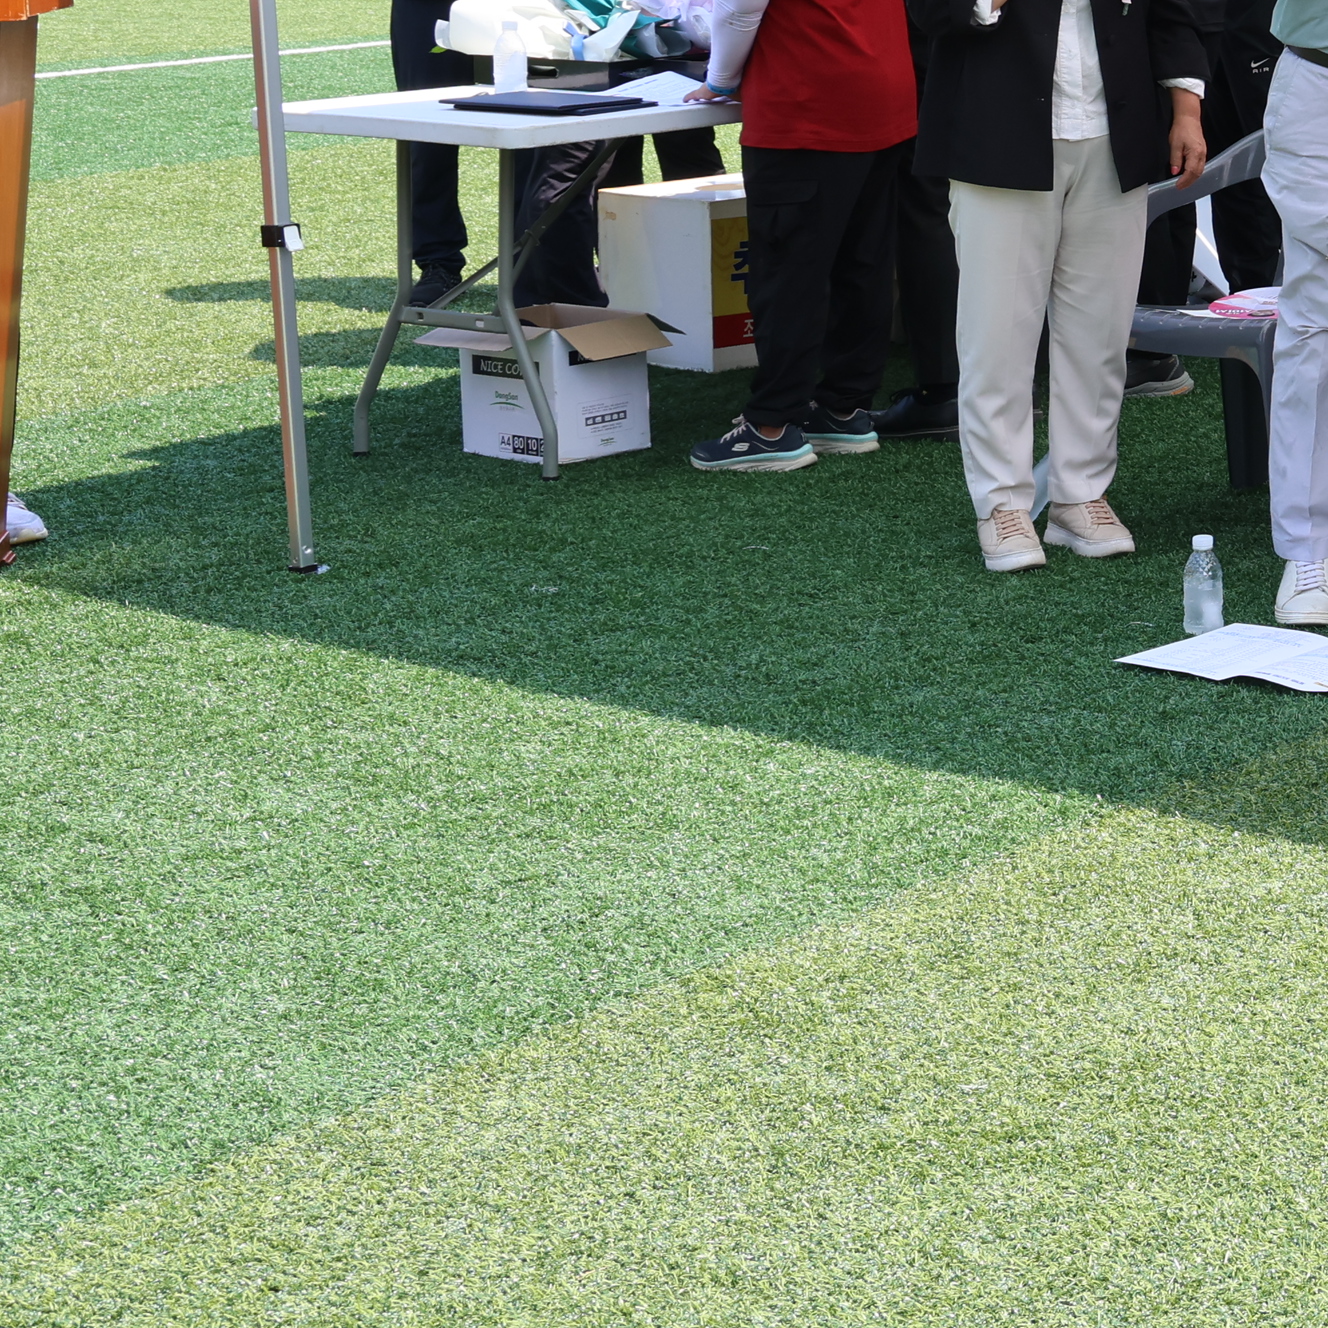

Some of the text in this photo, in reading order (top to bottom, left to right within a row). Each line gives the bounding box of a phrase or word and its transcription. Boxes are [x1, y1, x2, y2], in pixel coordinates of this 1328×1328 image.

[480, 359, 503, 374] NICE
[500, 435, 511, 447] A4
[513, 436, 524, 449] 80
[527, 439, 538, 451] 10
